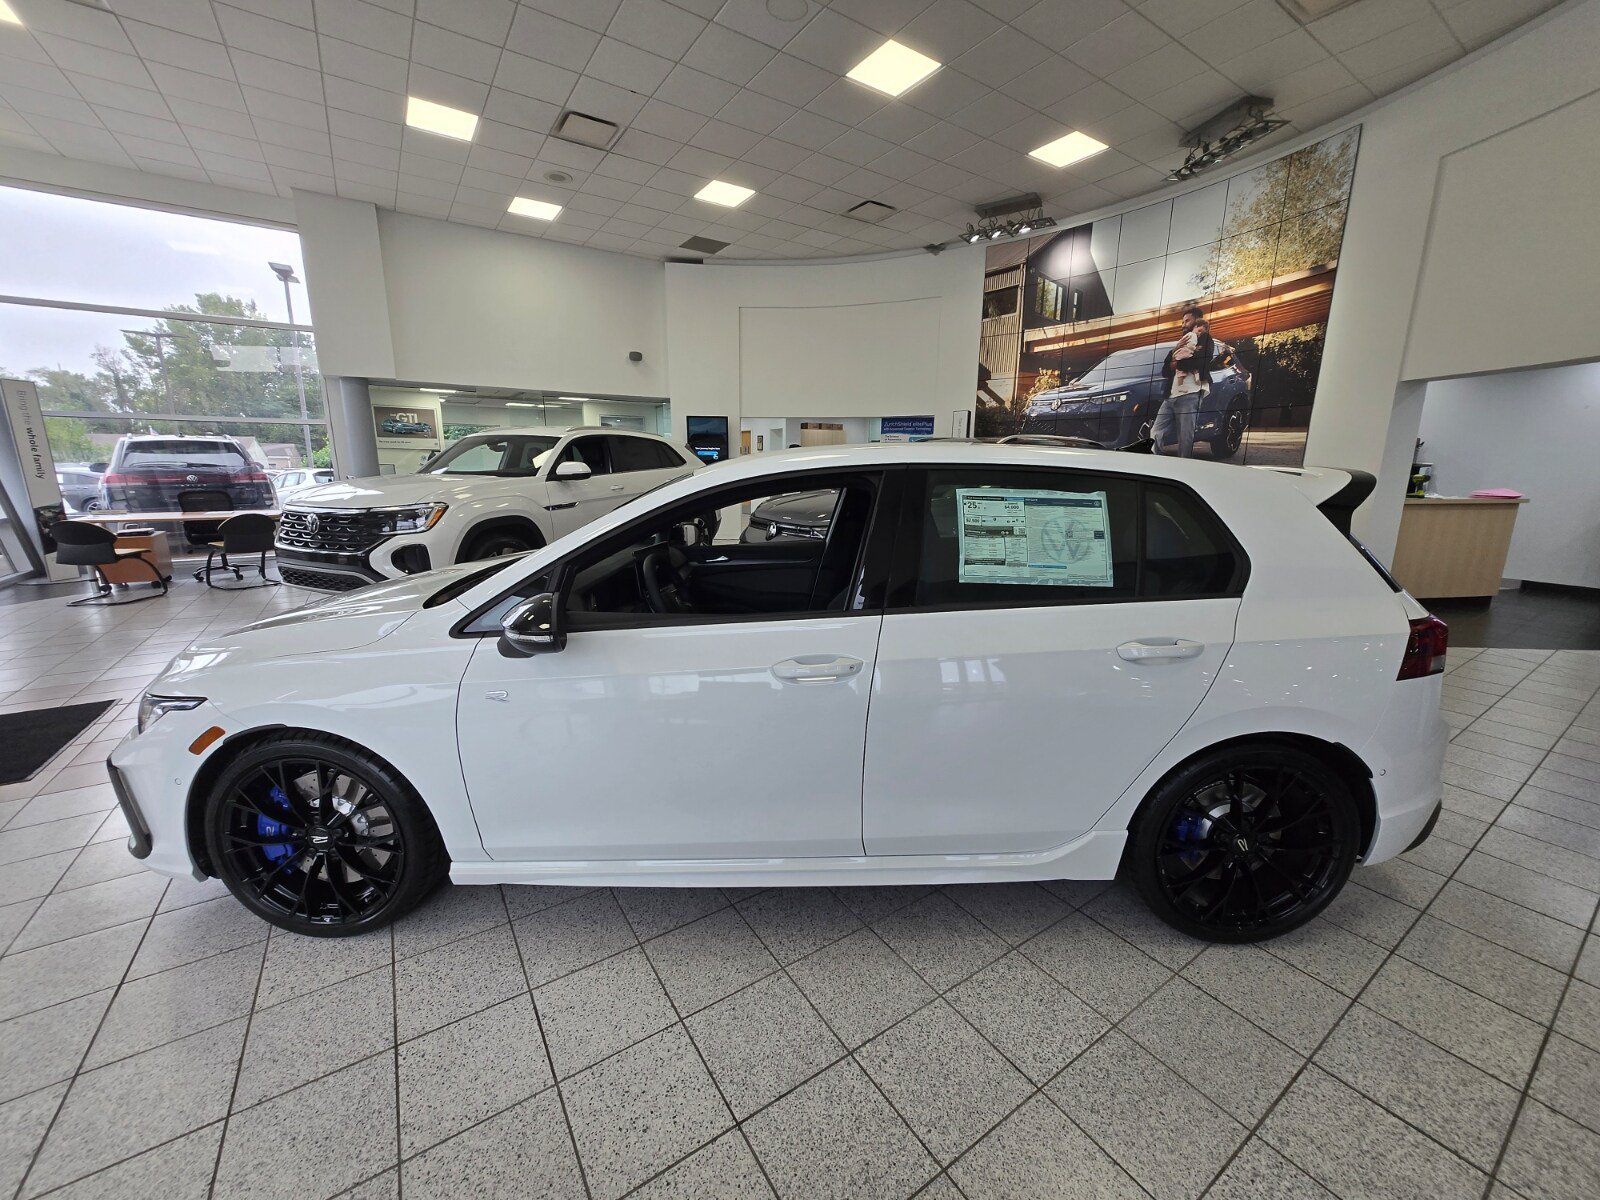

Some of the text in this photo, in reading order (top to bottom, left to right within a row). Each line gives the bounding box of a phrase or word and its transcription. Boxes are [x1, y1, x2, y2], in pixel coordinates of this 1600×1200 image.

[396, 412, 418, 424] GTI
[16, 390, 47, 480] Bring the whole family
[967, 501, 978, 509] 25
